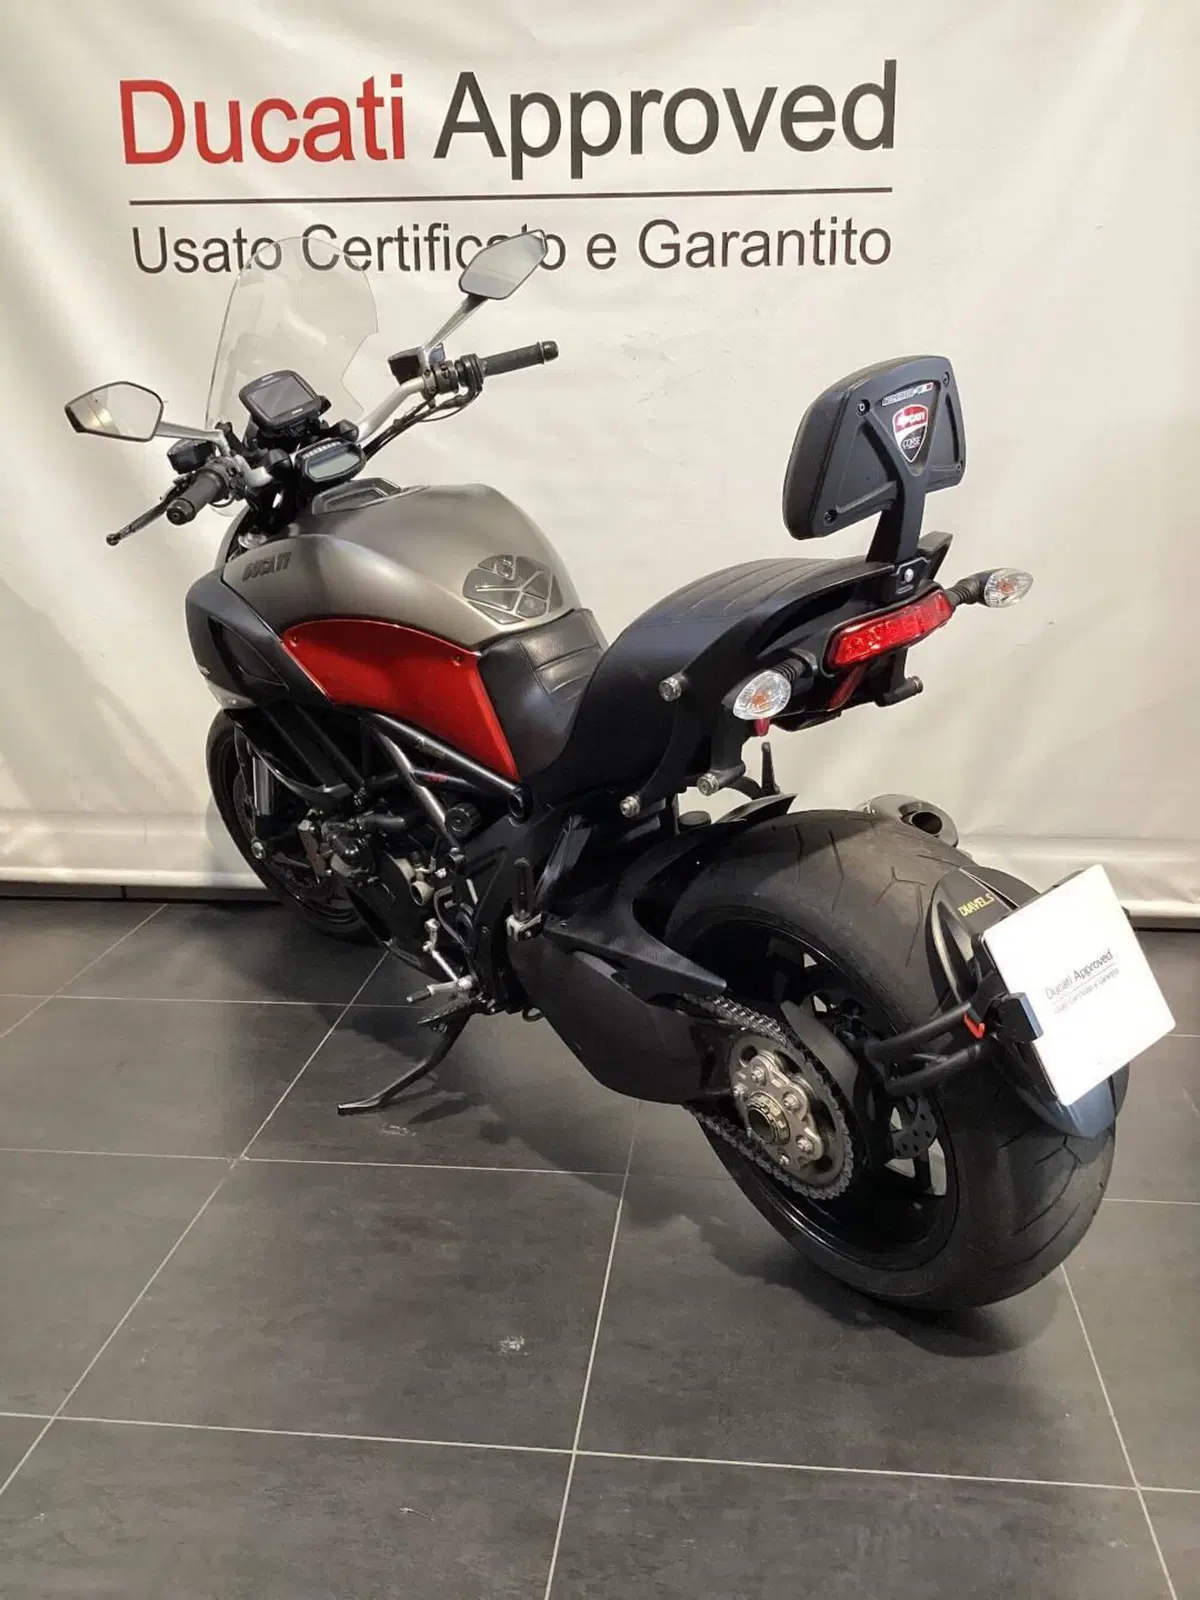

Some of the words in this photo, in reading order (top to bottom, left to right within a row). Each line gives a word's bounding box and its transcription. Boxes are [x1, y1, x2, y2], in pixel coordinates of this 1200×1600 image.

[119, 73, 405, 165] Ducati
[432, 59, 897, 180] Approved
[132, 226, 282, 274] Usato
[301, 222, 566, 272] Certifico
[586, 232, 617, 269] e
[638, 215, 892, 269] Garantito
[1073, 948, 1113, 982] Approved
